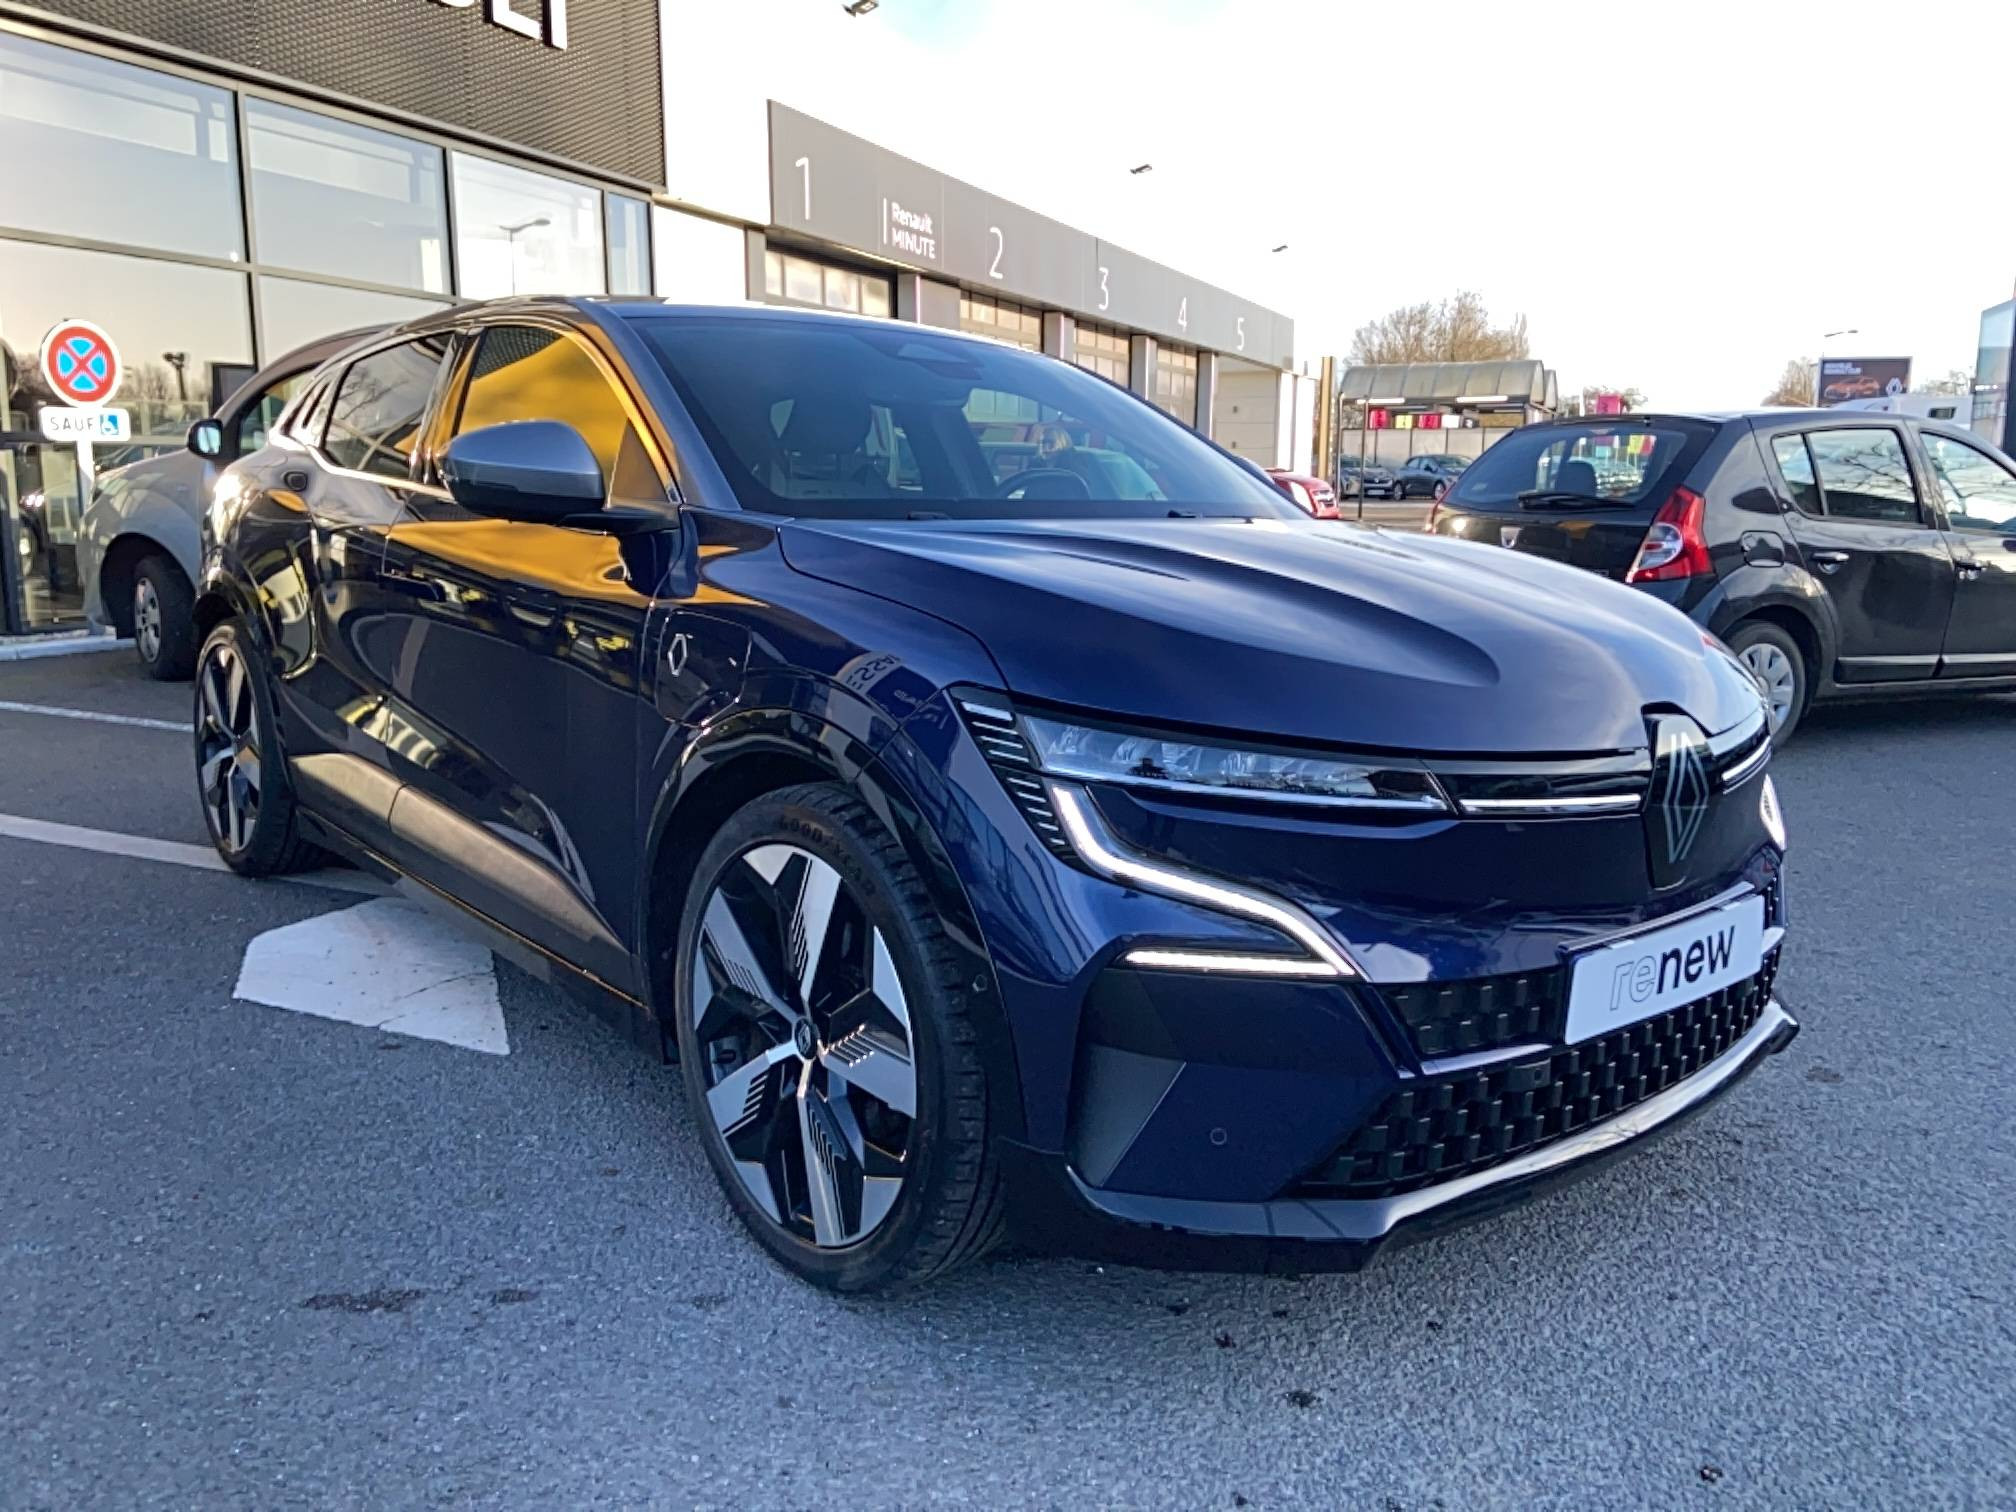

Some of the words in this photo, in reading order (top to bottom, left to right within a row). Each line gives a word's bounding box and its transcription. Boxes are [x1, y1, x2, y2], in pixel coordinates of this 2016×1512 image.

[795, 156, 810, 220] 1
[891, 201, 933, 235] Renault
[891, 226, 936, 260] MINUTE
[989, 226, 1004, 280] 2
[1098, 266, 1110, 311] 3
[1177, 296, 1188, 333] 4
[1236, 317, 1246, 351] 5
[50, 416, 95, 432] SAUF
[1609, 925, 1736, 1012] renew
